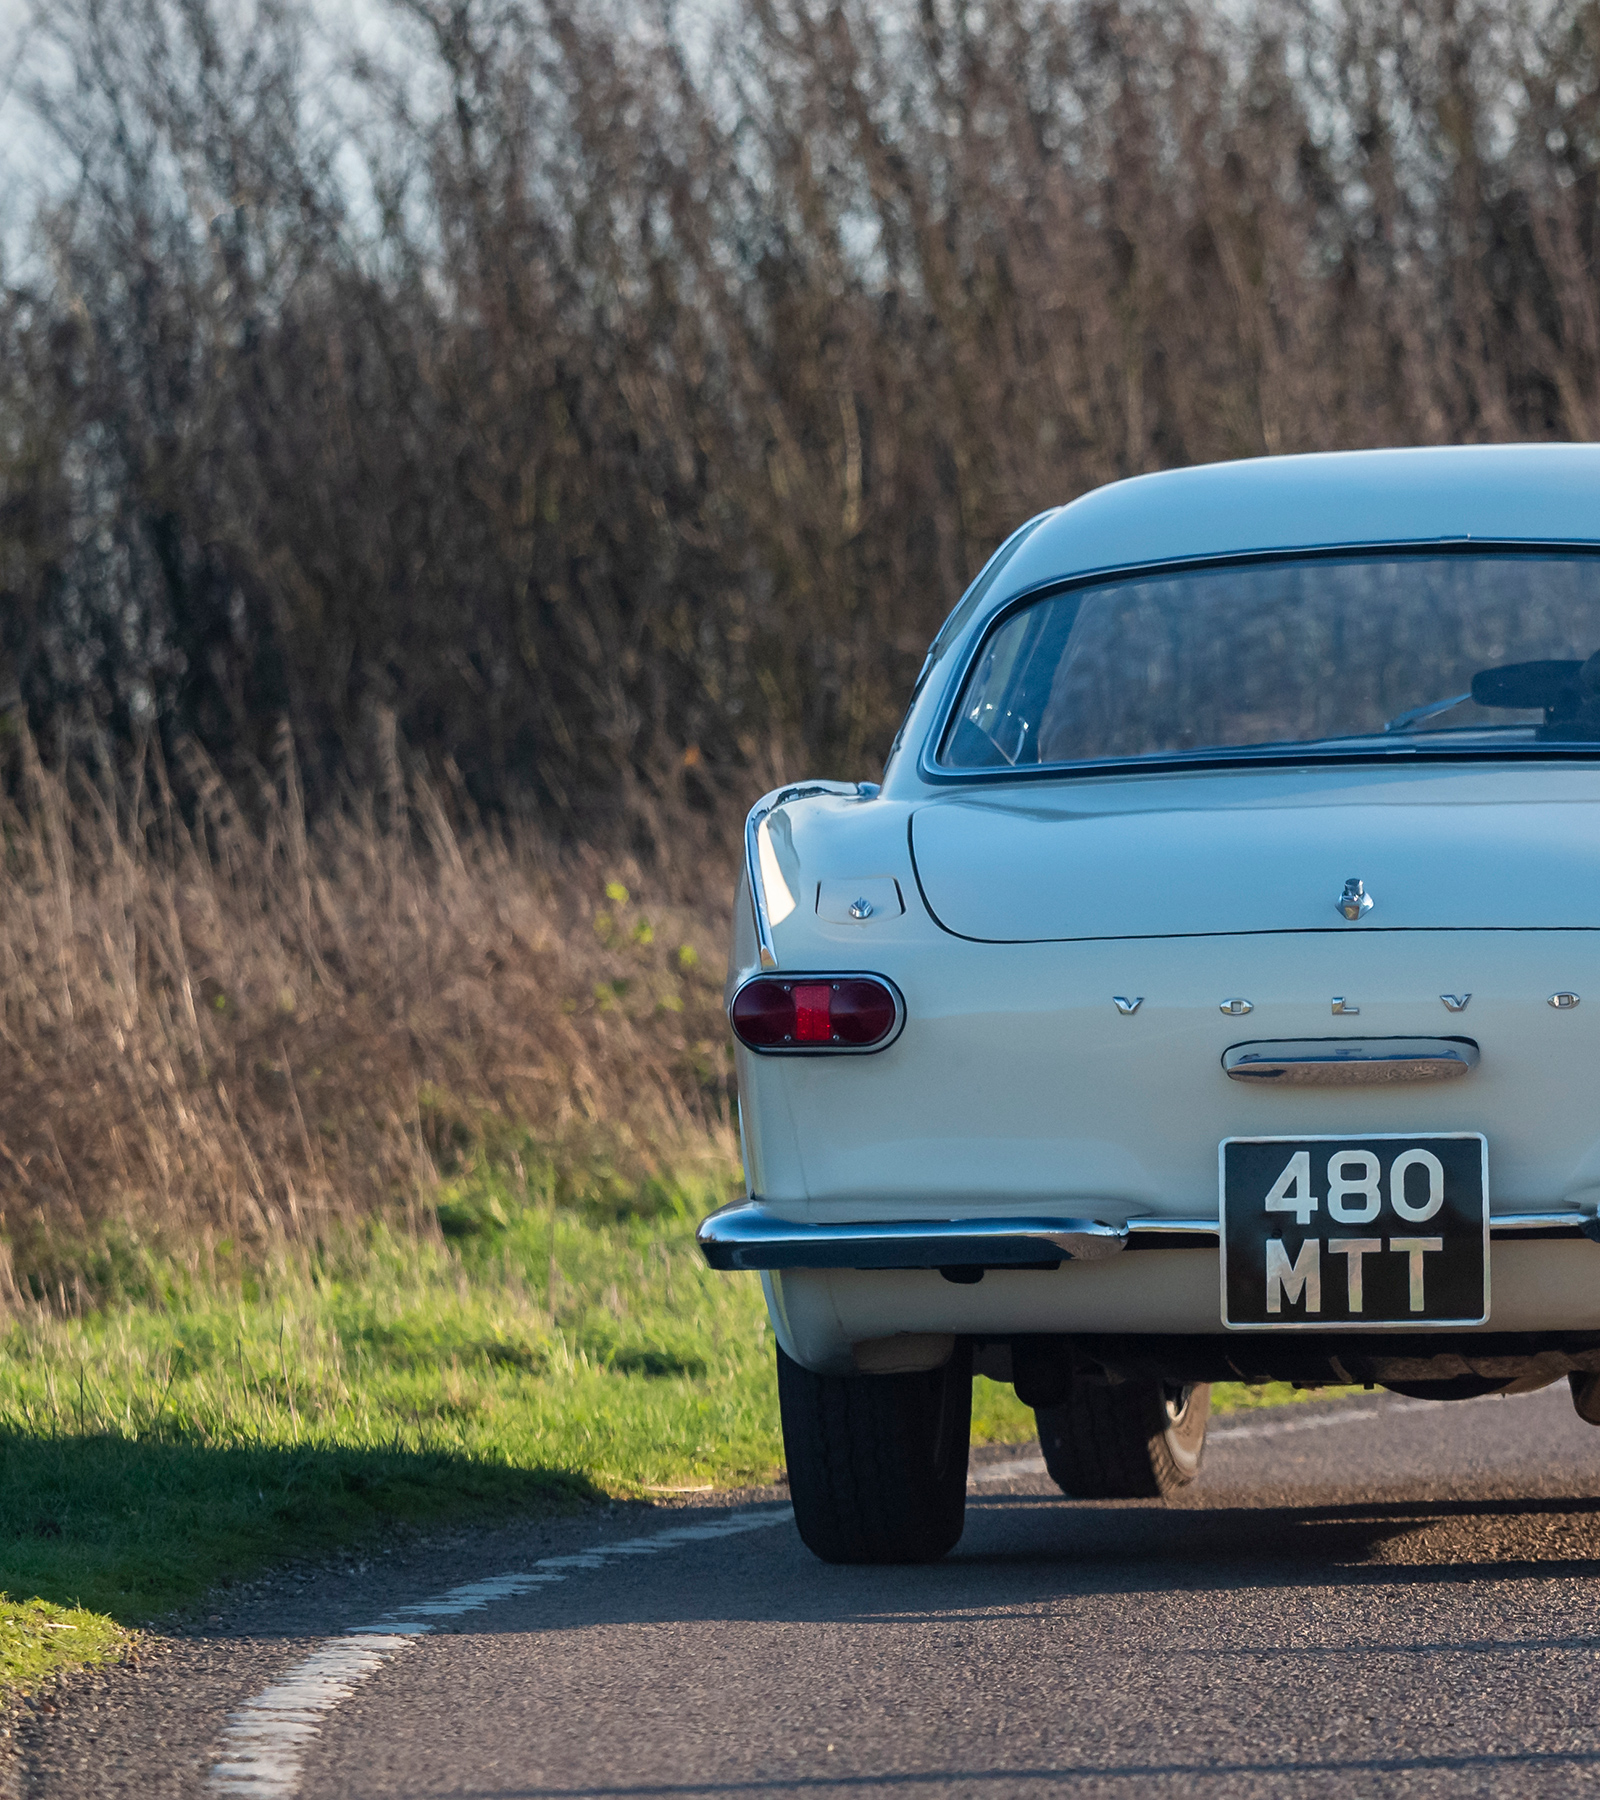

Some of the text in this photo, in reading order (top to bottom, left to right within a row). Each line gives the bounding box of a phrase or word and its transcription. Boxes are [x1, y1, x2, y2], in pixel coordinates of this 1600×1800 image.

[1112, 991, 1581, 1015] VOLVO
[1265, 1149, 1444, 1225] 480
[1266, 1236, 1443, 1313] MTT
